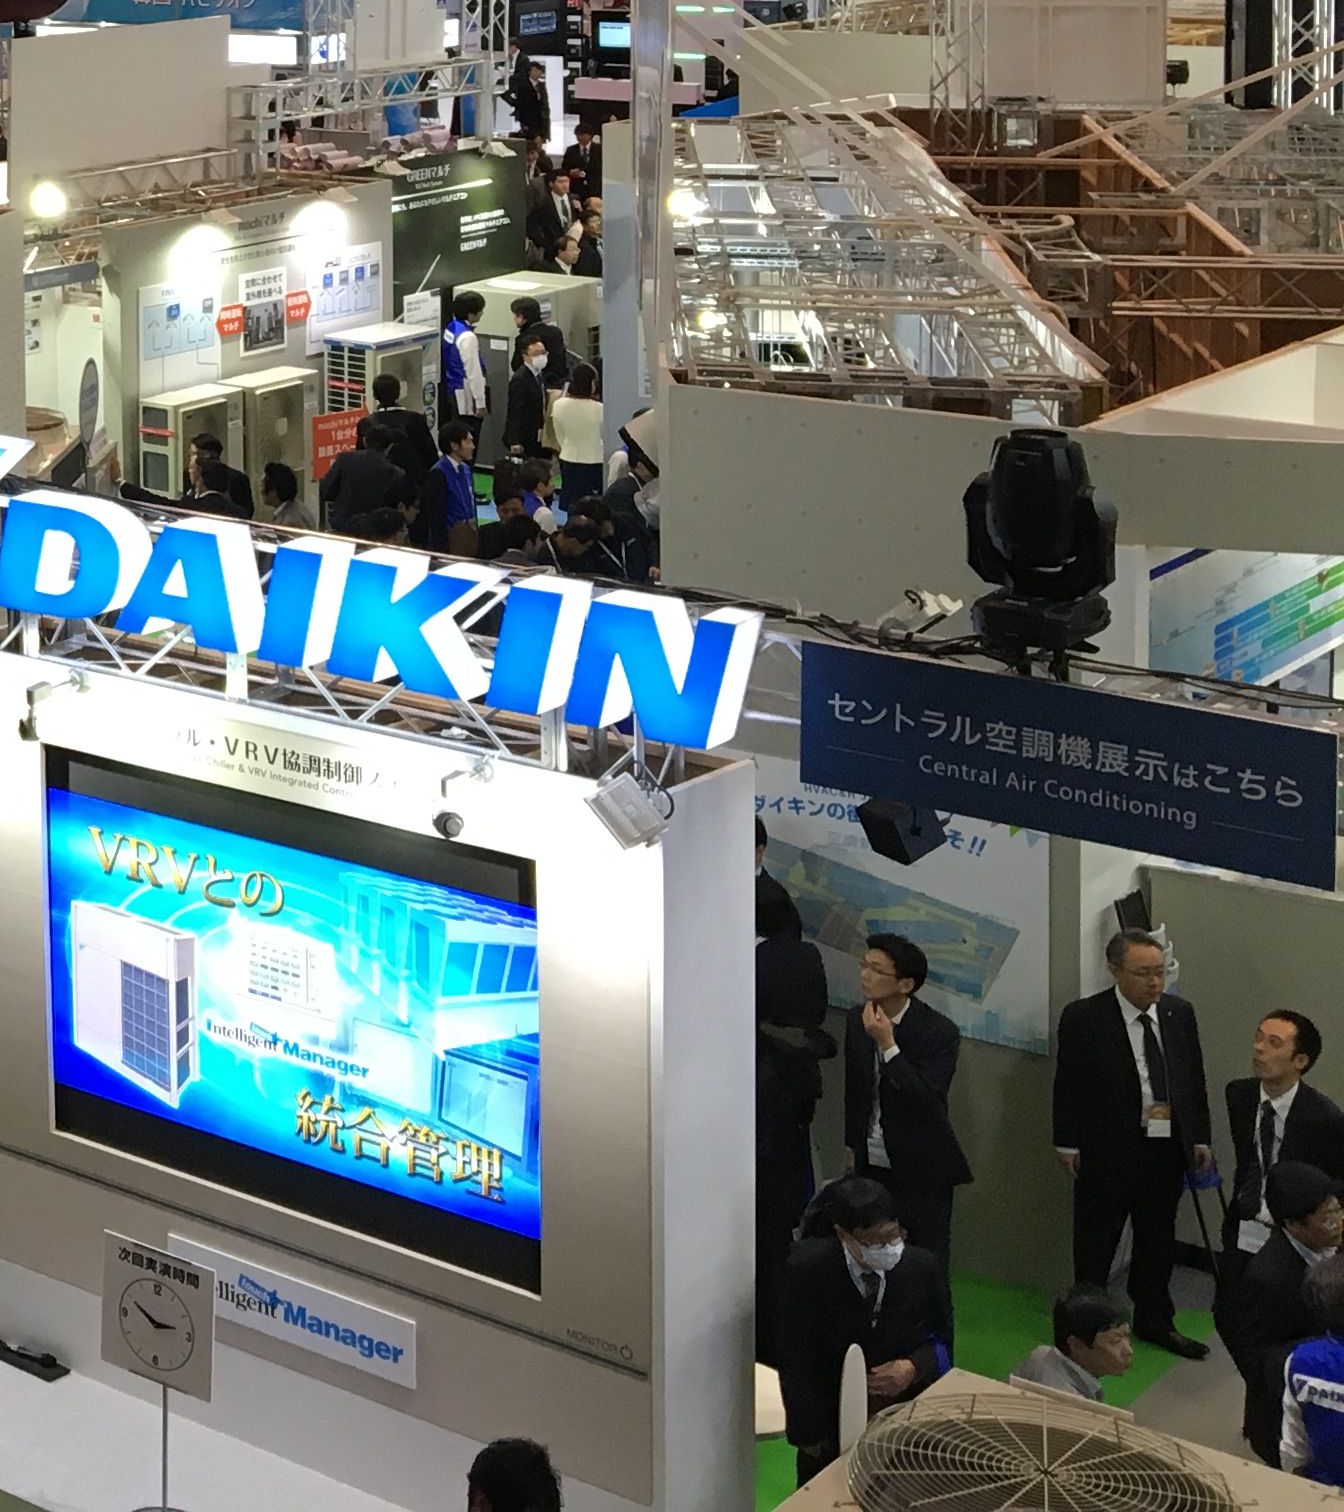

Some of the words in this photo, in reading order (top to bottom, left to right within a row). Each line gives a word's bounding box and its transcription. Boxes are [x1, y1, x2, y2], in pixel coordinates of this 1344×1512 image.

[826, 692, 1305, 811] セントラル空調機展示はこちら
[247, 765, 268, 779] VRV
[269, 771, 320, 792] Integrated
[918, 754, 998, 787] Central
[1005, 771, 1037, 795] Air
[1043, 780, 1199, 831] Conditioning
[87, 825, 285, 917] VRVとの
[282, 1039, 370, 1079] Manager
[294, 1085, 505, 1204] 統合管理
[118, 1246, 200, 1289] 次回実演時間
[153, 1283, 162, 1297] 12
[122, 1306, 128, 1317] 9
[185, 1332, 192, 1343] 3
[283, 1301, 404, 1364] Manager
[152, 1355, 159, 1366] 6
